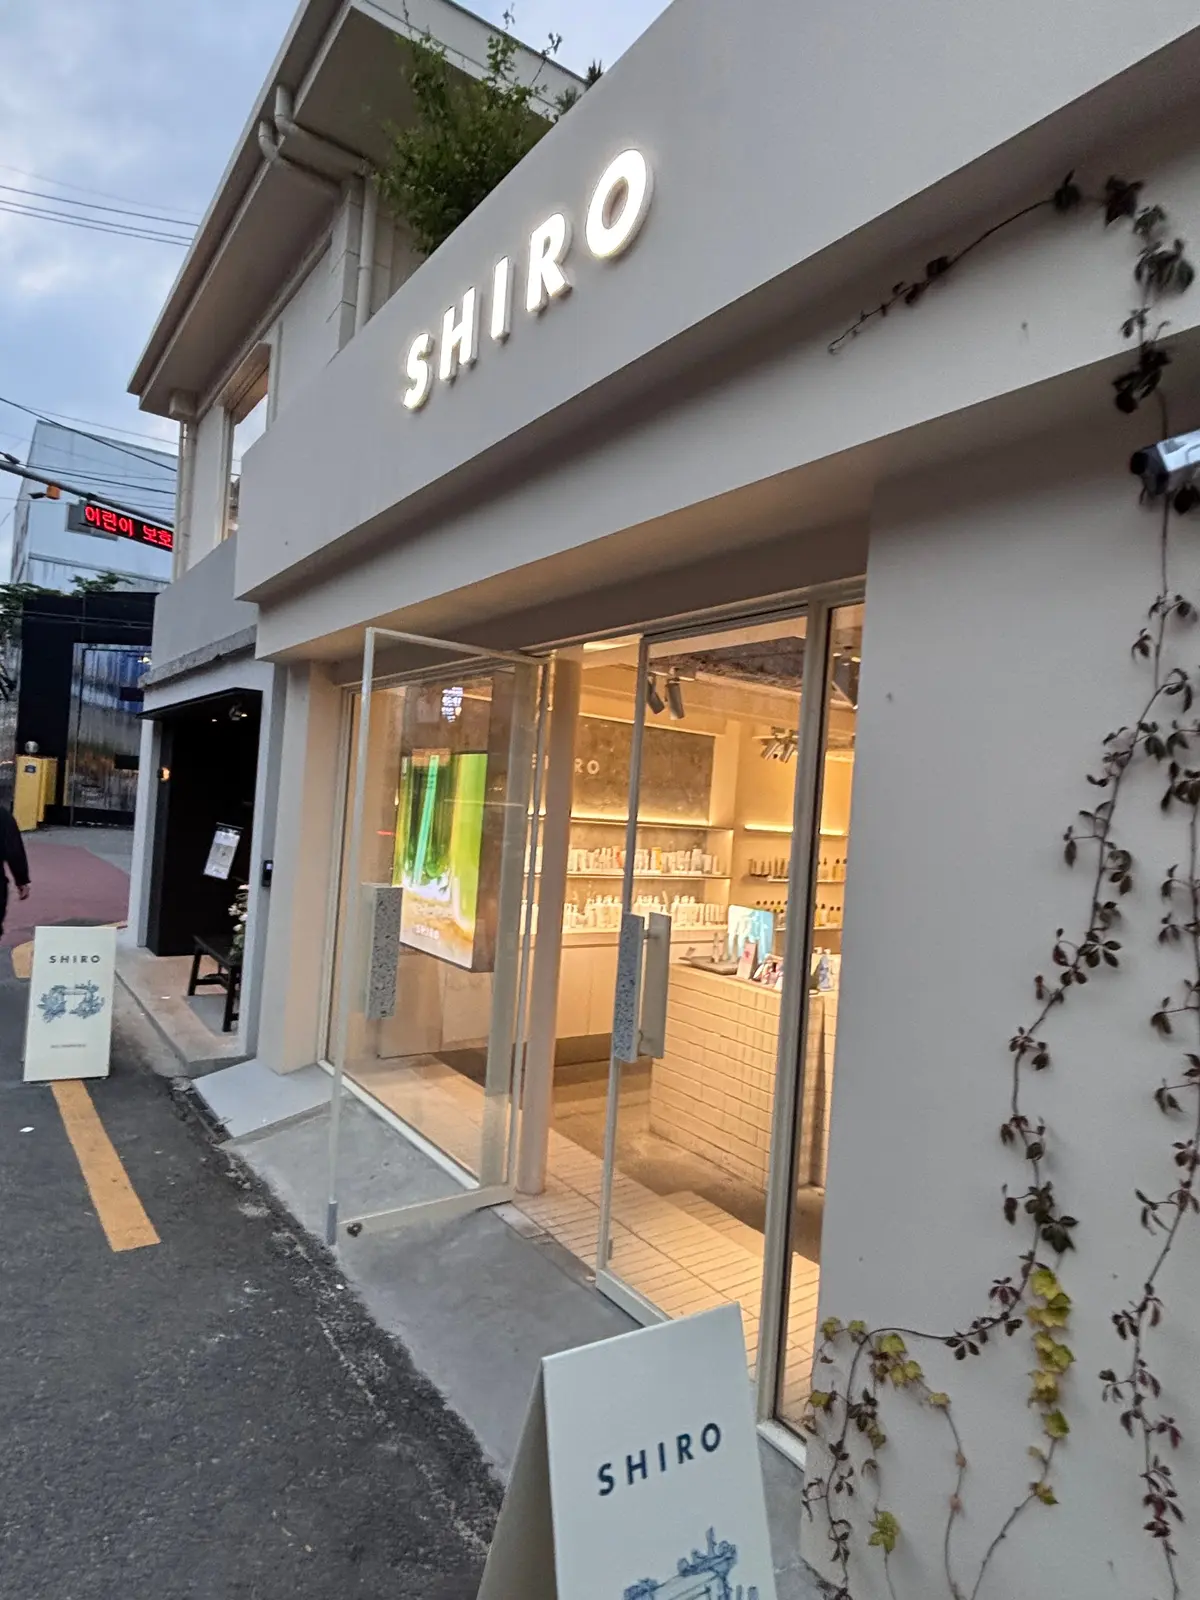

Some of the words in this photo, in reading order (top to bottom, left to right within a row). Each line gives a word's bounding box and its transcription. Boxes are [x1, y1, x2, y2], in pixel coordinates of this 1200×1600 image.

[402, 148, 653, 410] SHIRO
[84, 506, 133, 537] 어린이
[143, 525, 173, 549] 보호
[49, 955, 101, 964] SHIRO
[597, 1422, 722, 1496] SHIRO
